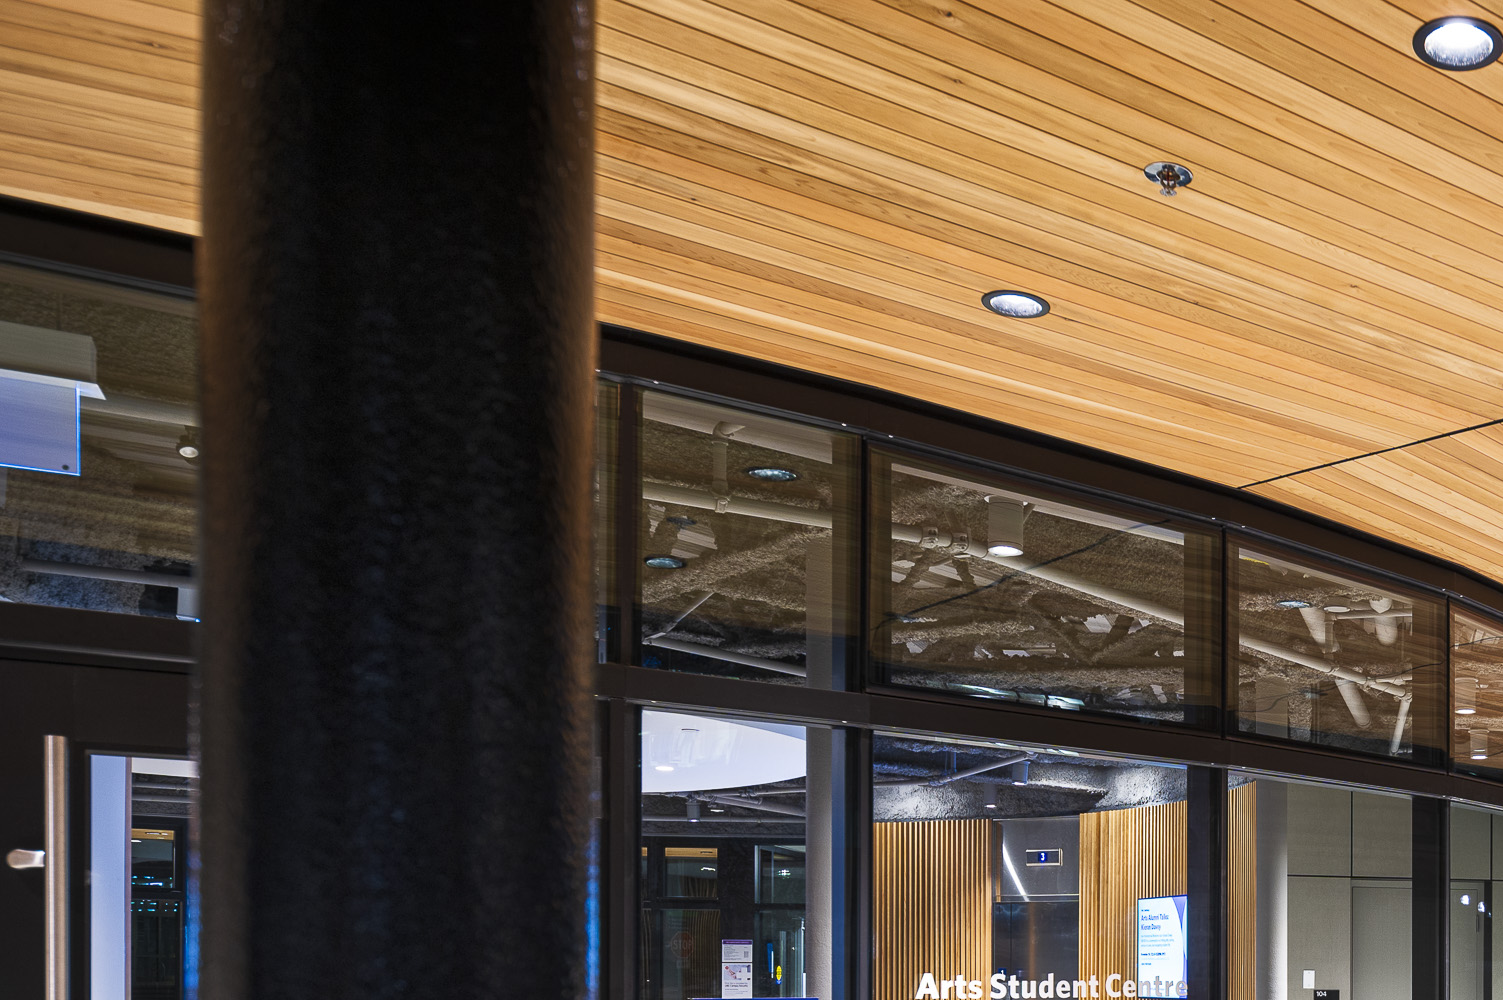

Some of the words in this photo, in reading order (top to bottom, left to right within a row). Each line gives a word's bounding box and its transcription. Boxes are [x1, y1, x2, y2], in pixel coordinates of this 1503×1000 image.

[1039, 852, 1046, 862] 3
[915, 973, 982, 999] Arts
[989, 972, 1099, 999] Student
[1105, 974, 1188, 998] Centre
